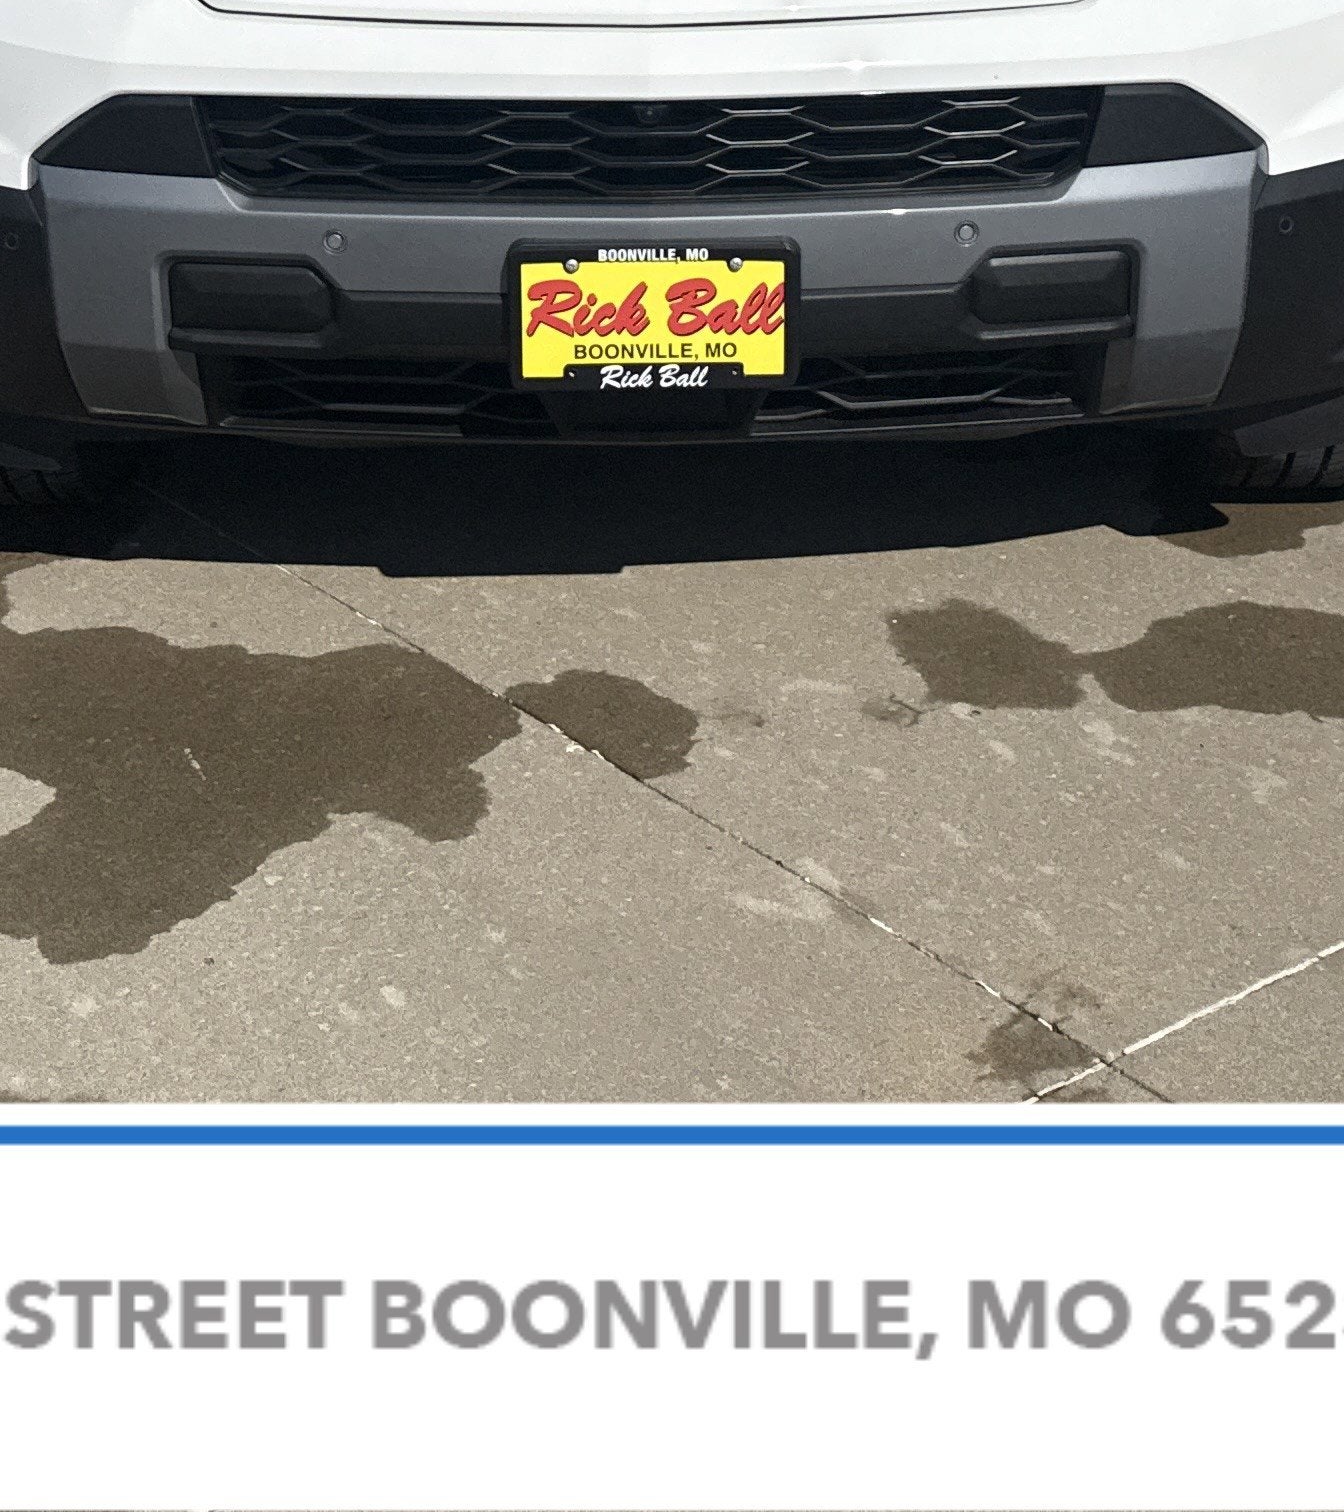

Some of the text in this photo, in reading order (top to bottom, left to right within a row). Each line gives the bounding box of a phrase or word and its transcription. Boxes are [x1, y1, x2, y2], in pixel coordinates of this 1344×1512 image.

[597, 248, 709, 264] BOONVILLE, MO
[525, 277, 786, 338] Rick Ball
[573, 342, 738, 361] BOONVILLE, MO
[600, 365, 709, 389] Rick Ball
